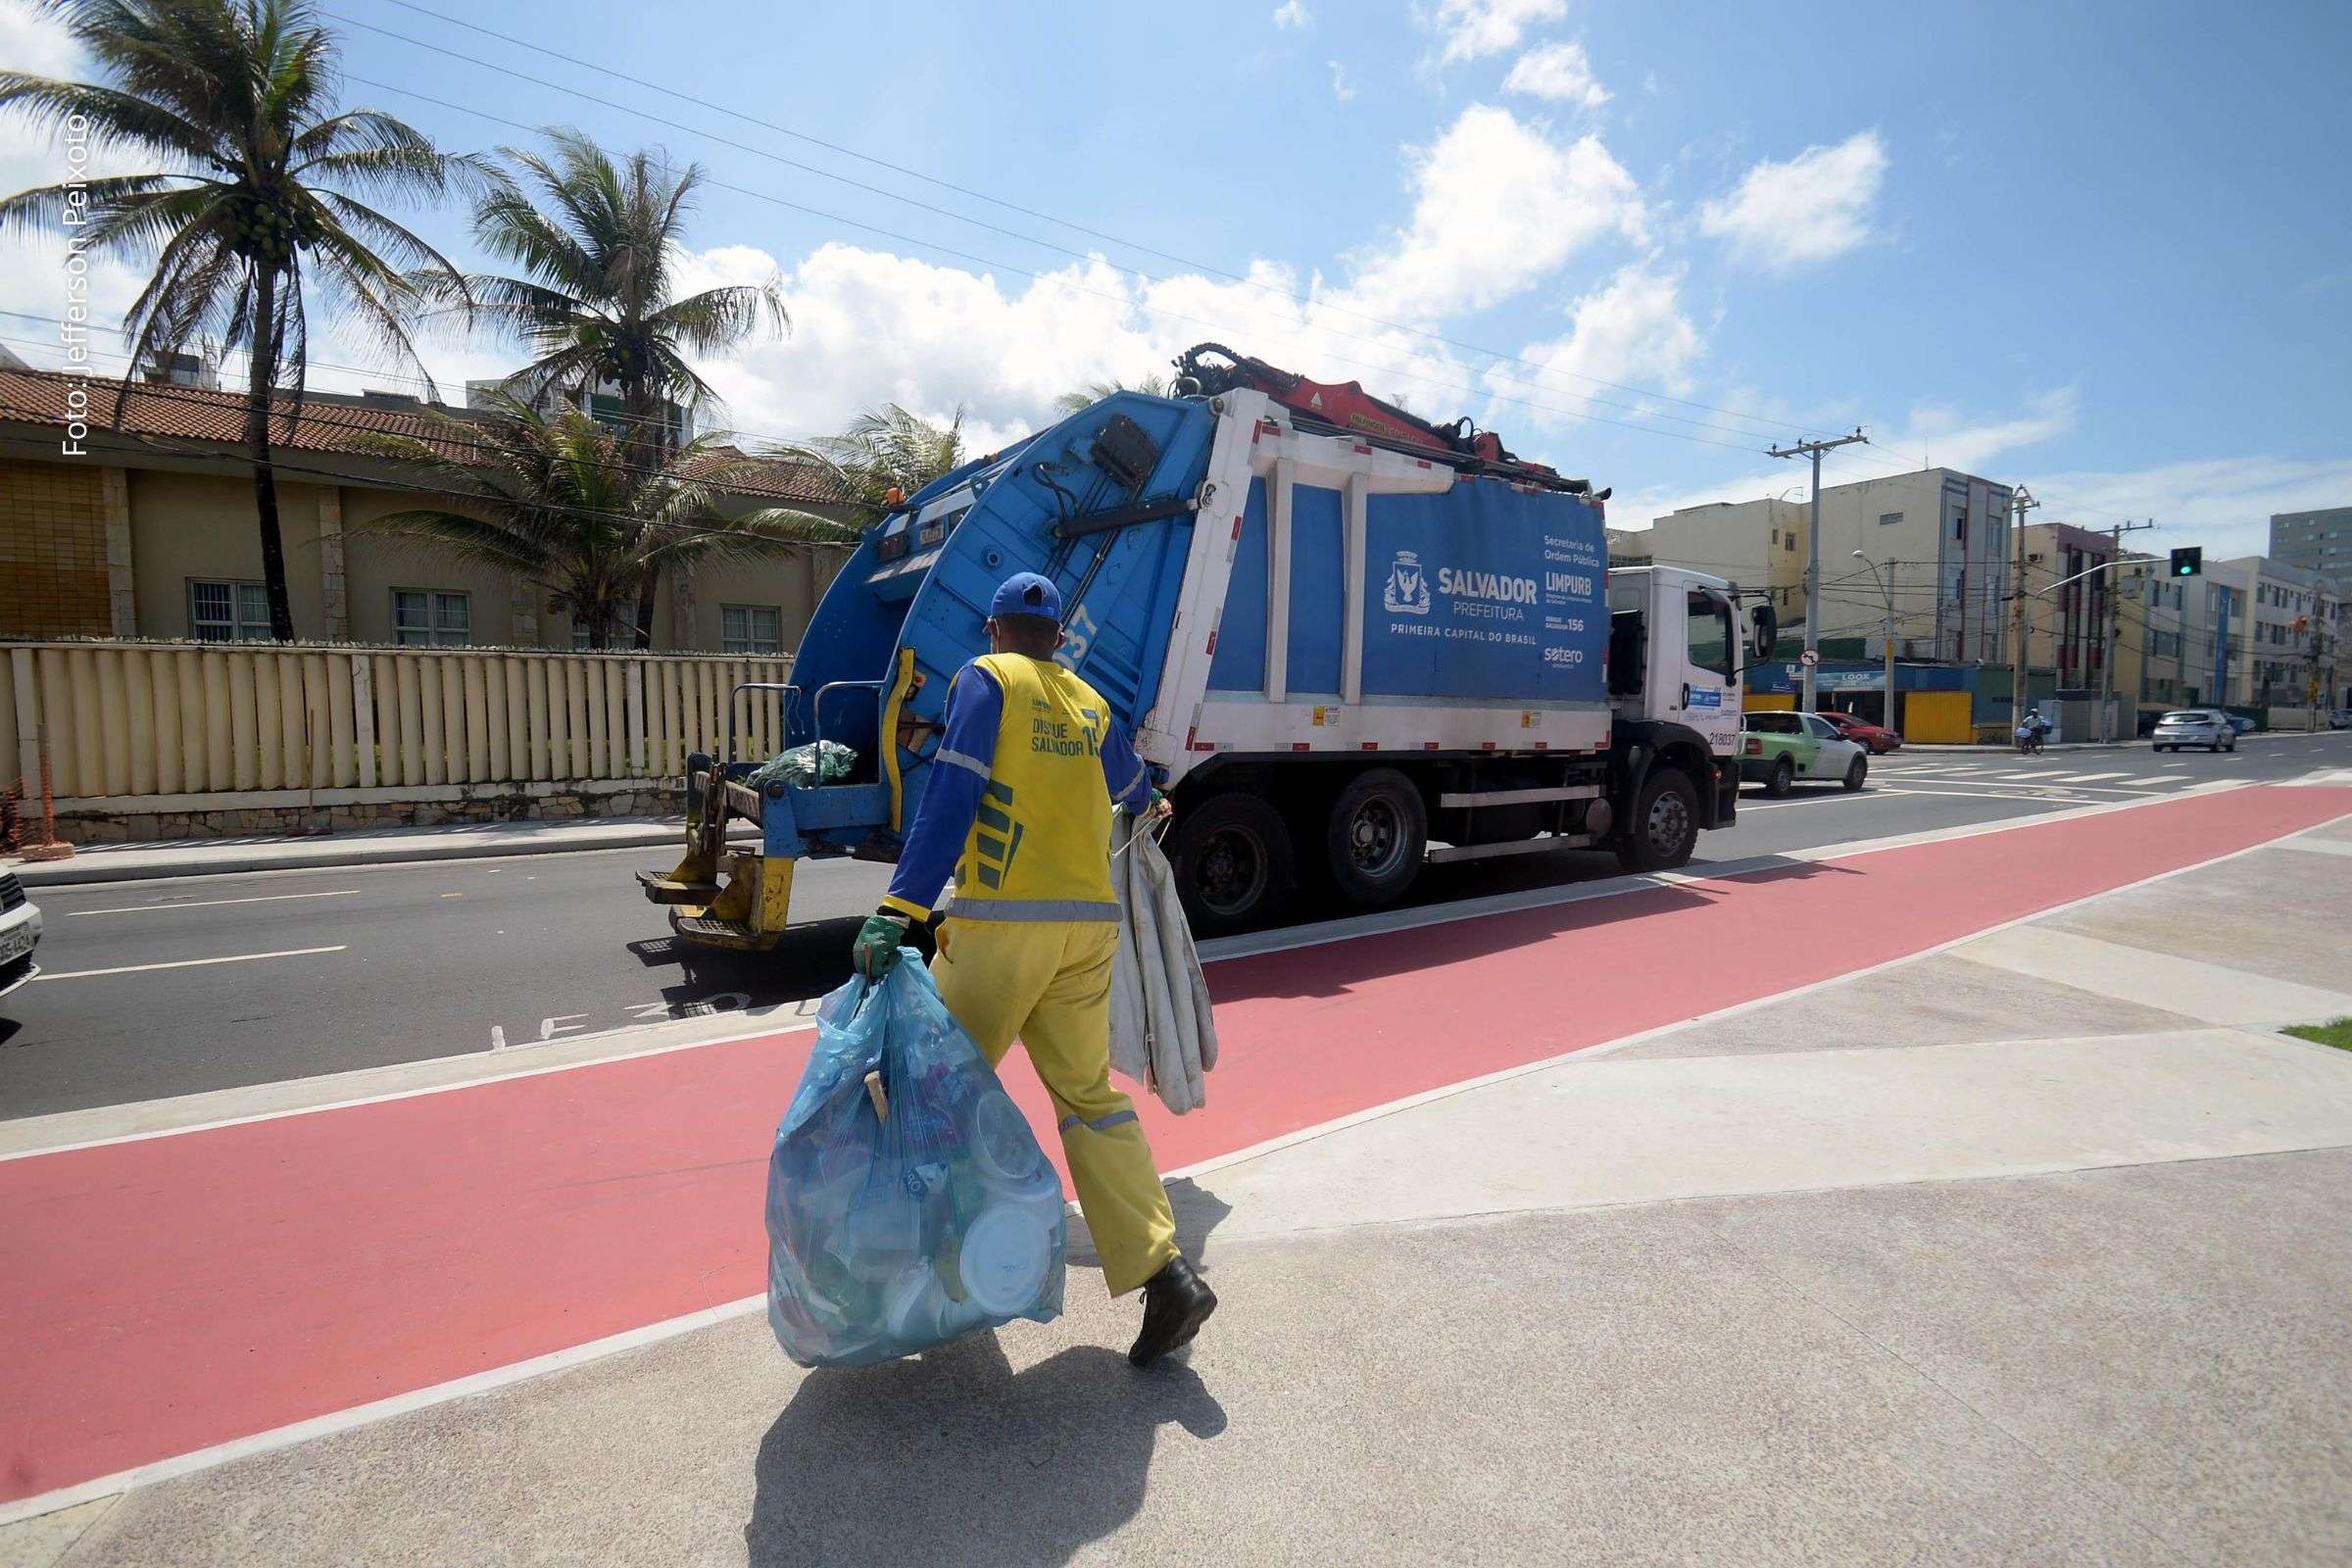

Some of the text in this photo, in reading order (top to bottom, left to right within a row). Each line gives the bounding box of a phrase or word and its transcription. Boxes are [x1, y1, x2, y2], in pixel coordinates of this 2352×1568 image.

[1544, 535, 1594, 553] Secretaria de
[1544, 549, 1600, 567] Ordem Pública
[1438, 566, 1538, 605] SALVADOR
[1545, 571, 1592, 596] LIMPURB
[1453, 601, 1525, 621] PREFEITURA
[1391, 623, 1538, 646] PRIMEIRA CAPITAL DO BRASIL
[1568, 617, 1584, 632] 156
[1033, 717, 1068, 739] DISUE
[1031, 736, 1084, 757] SALVADOR
